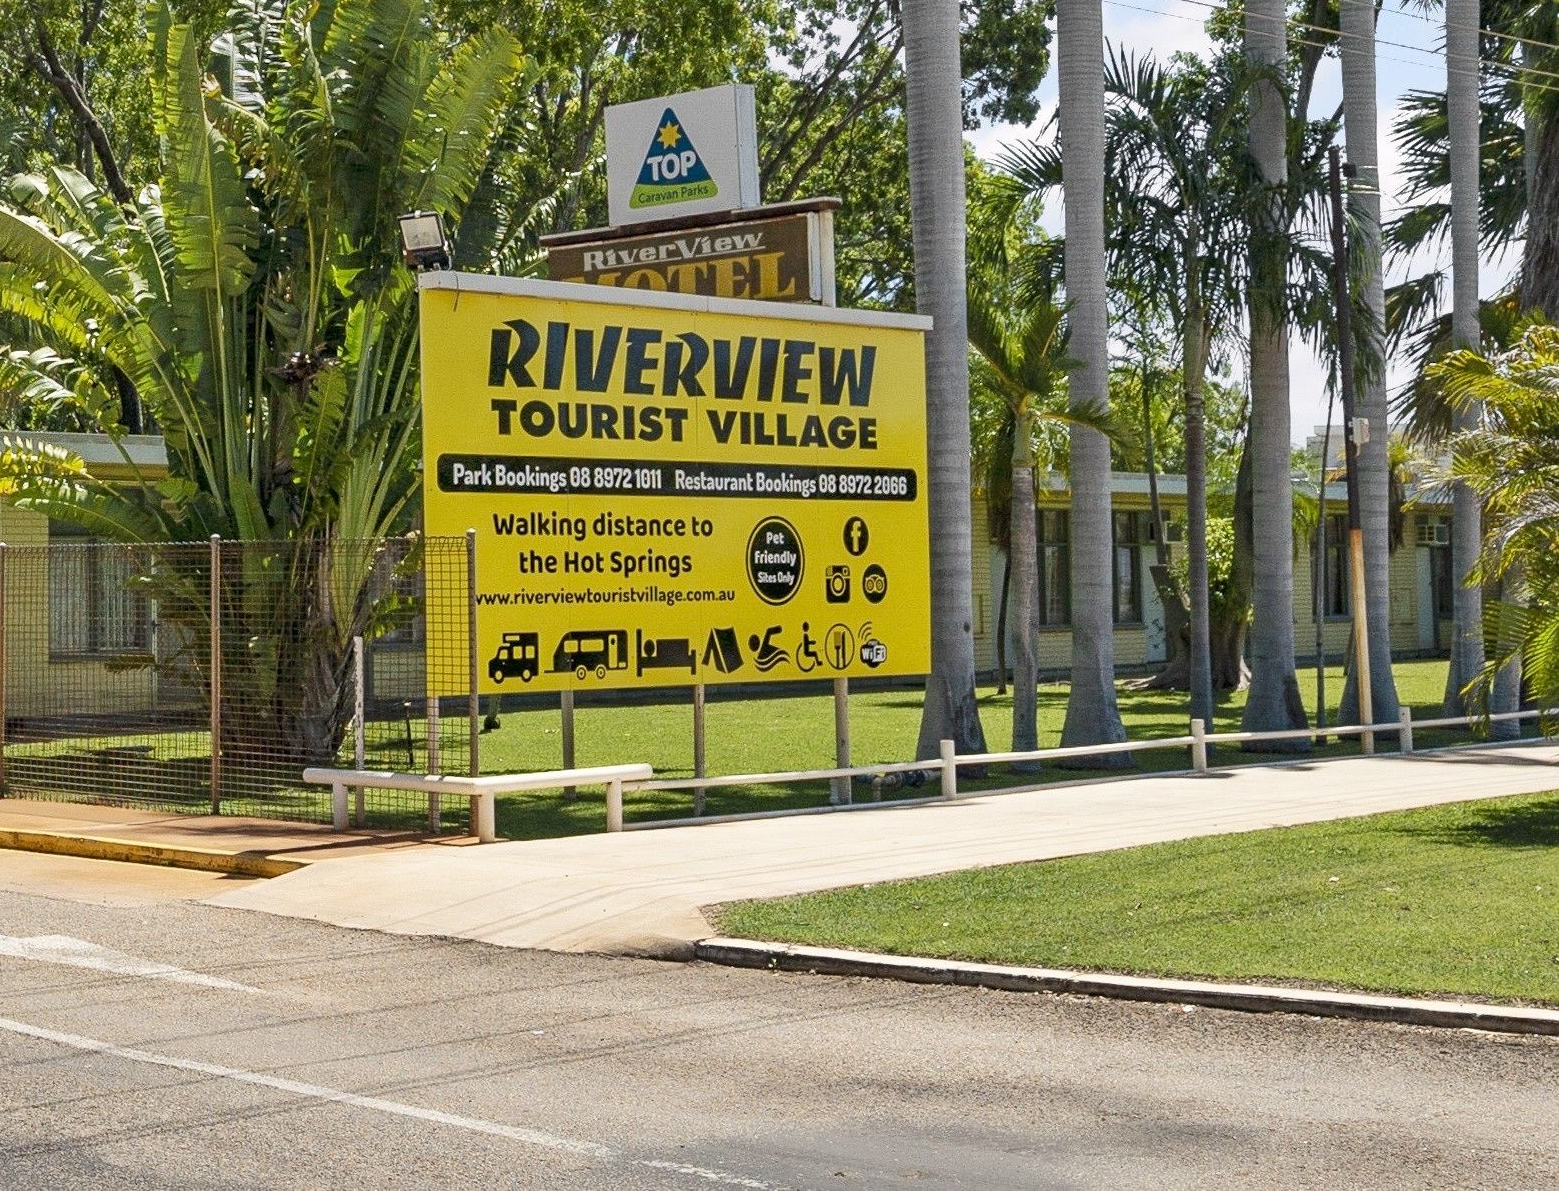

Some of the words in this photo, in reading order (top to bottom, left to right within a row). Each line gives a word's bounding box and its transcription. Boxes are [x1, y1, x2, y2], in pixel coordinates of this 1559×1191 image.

[646, 150, 697, 181] TOP
[637, 188, 679, 204] Caravan
[680, 185, 710, 199] Parks
[583, 232, 764, 272] RiverView
[488, 319, 877, 407] RIVERVIEW
[491, 398, 688, 442] TOURIST
[706, 409, 878, 450] VILLAGE
[452, 463, 492, 486] Park
[495, 465, 567, 492] Bookings
[570, 466, 591, 488] 08
[593, 467, 633, 488] 8972
[635, 468, 662, 489] 1011
[674, 469, 753, 492] Restaurant
[756, 472, 816, 497] Bookings
[819, 474, 837, 493] 08
[839, 474, 873, 494] 8972
[874, 476, 907, 495] 2066
[492, 511, 586, 541] Walking
[593, 512, 686, 537] distance
[691, 516, 713, 536] to
[766, 531, 785, 545] Pet
[519, 550, 558, 573] the
[564, 551, 605, 573] Hot
[610, 548, 692, 578] Springs
[757, 571, 777, 584] Sites
[777, 571, 795, 586] Only
